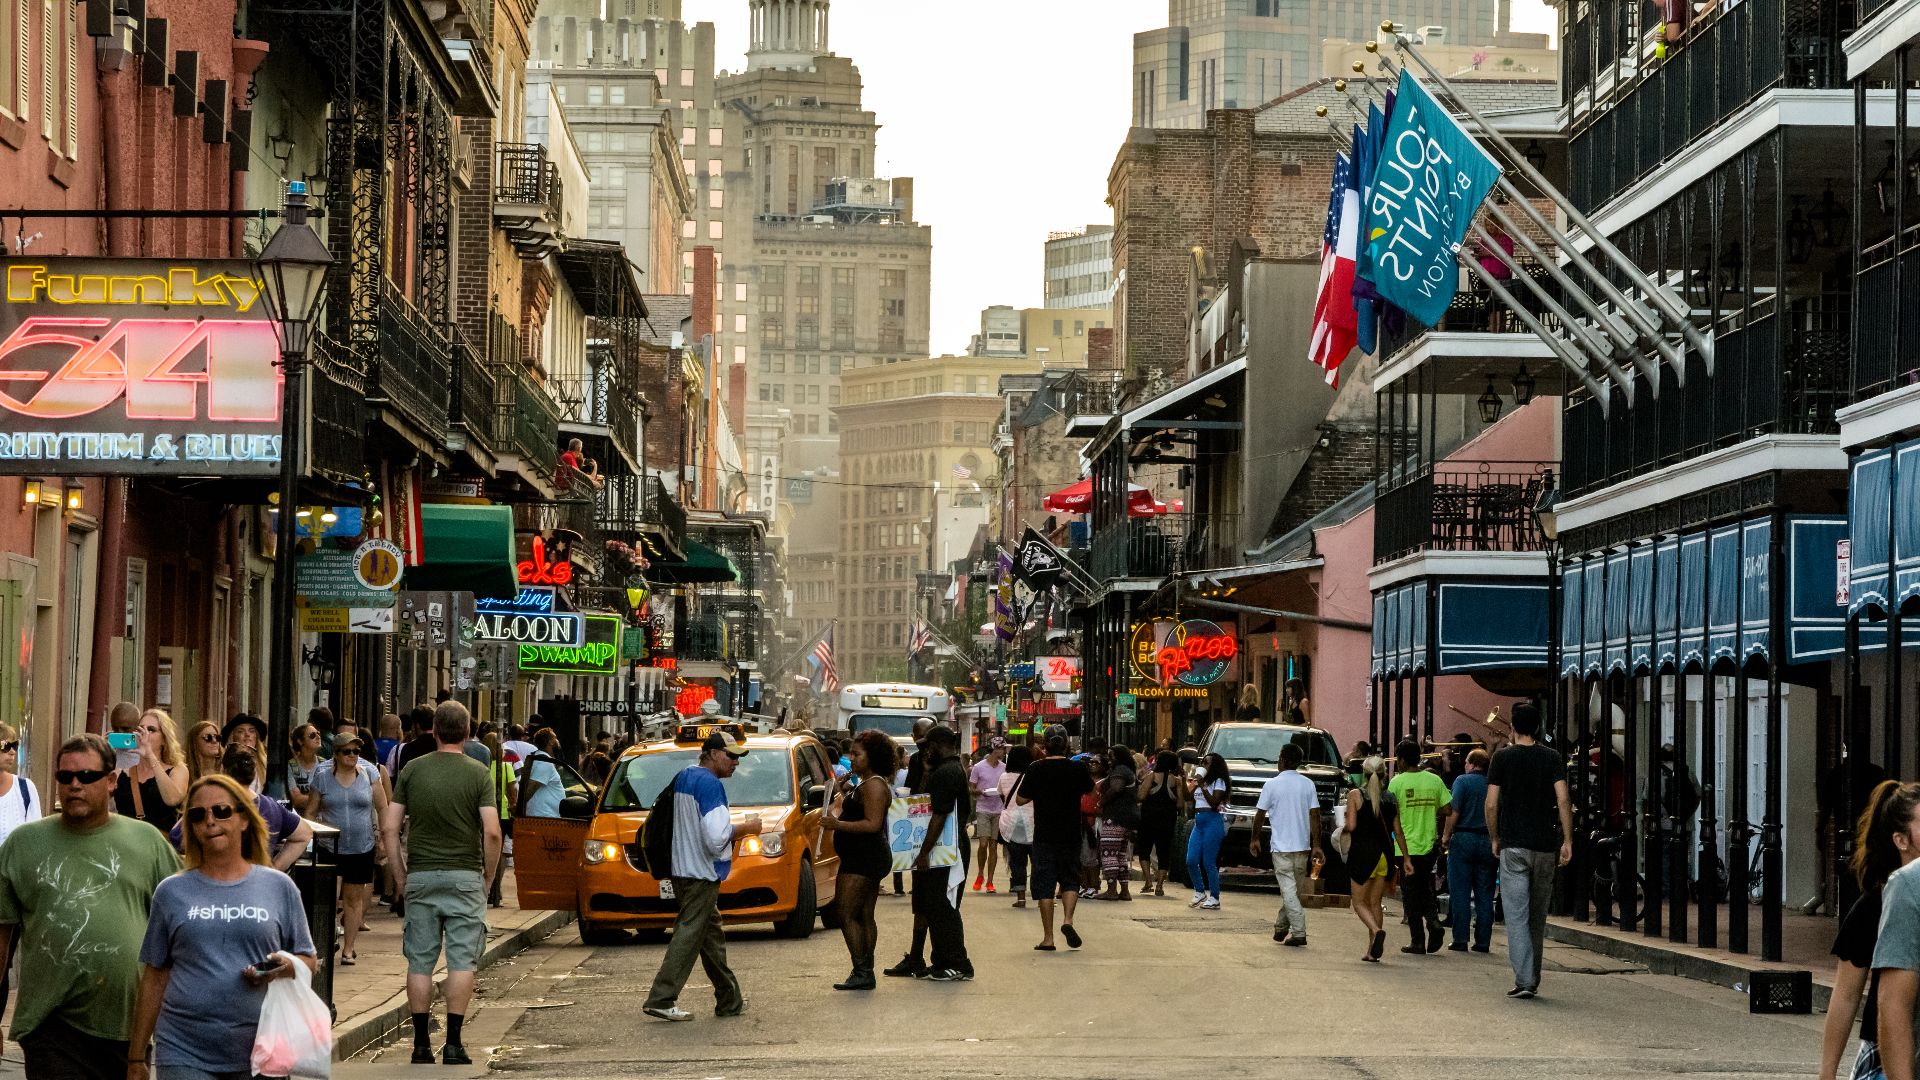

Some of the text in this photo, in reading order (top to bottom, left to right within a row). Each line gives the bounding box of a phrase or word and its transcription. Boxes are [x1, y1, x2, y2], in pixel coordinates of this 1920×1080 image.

[7, 265, 265, 312] Funky
[150, 433, 179, 461] &
[521, 643, 615, 666] SWAMP
[1128, 688, 1208, 697] BALCONY DINING
[579, 701, 611, 712] CHRIS
[186, 904, 270, 923] #shiplap
